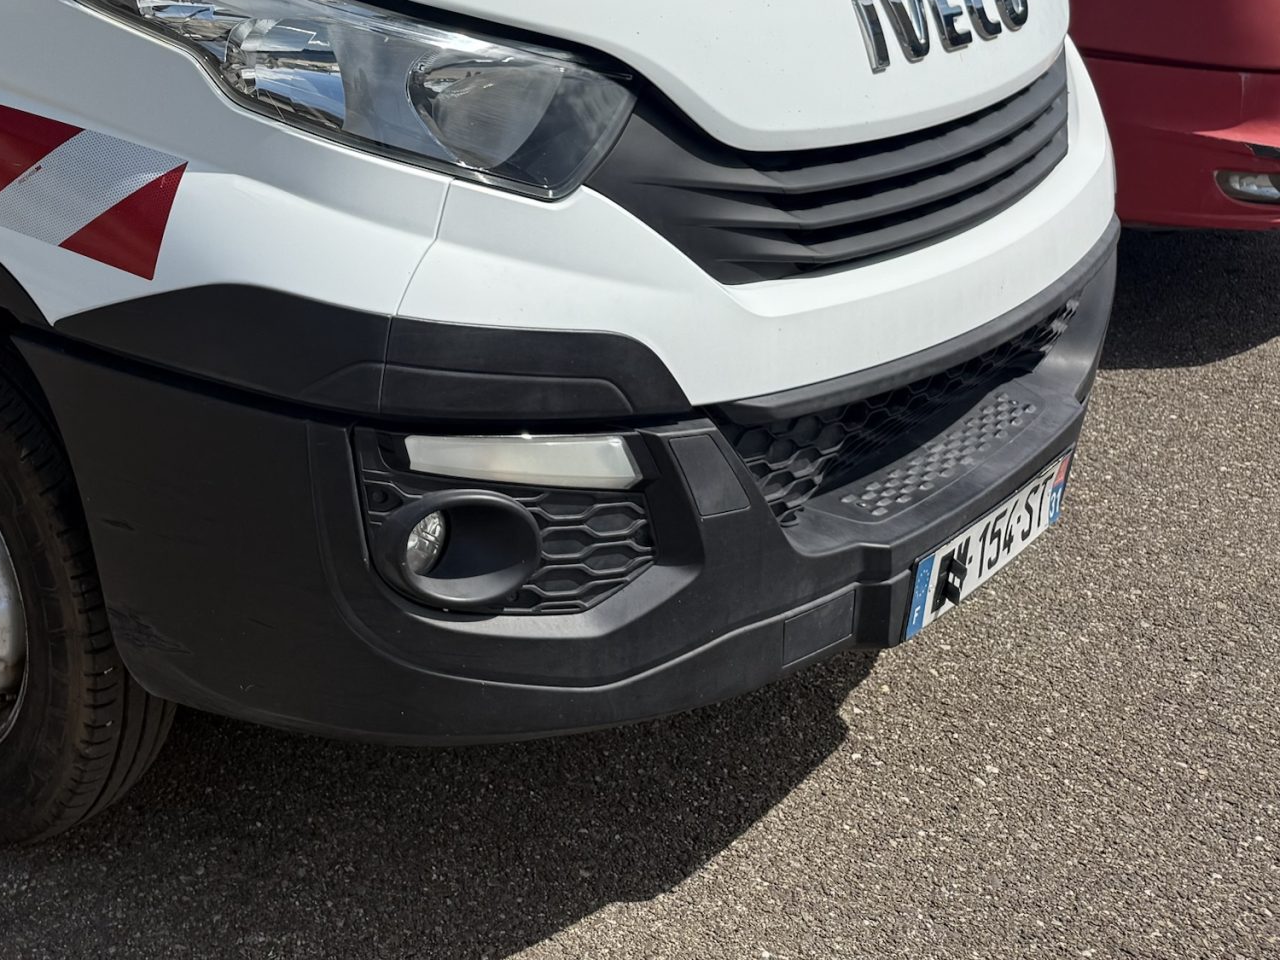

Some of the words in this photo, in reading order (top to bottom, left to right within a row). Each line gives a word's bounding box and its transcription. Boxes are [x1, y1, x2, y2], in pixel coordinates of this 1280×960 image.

[1049, 487, 1063, 519] 31
[931, 472, 1055, 614] -154-ST
[912, 605, 921, 626] F
